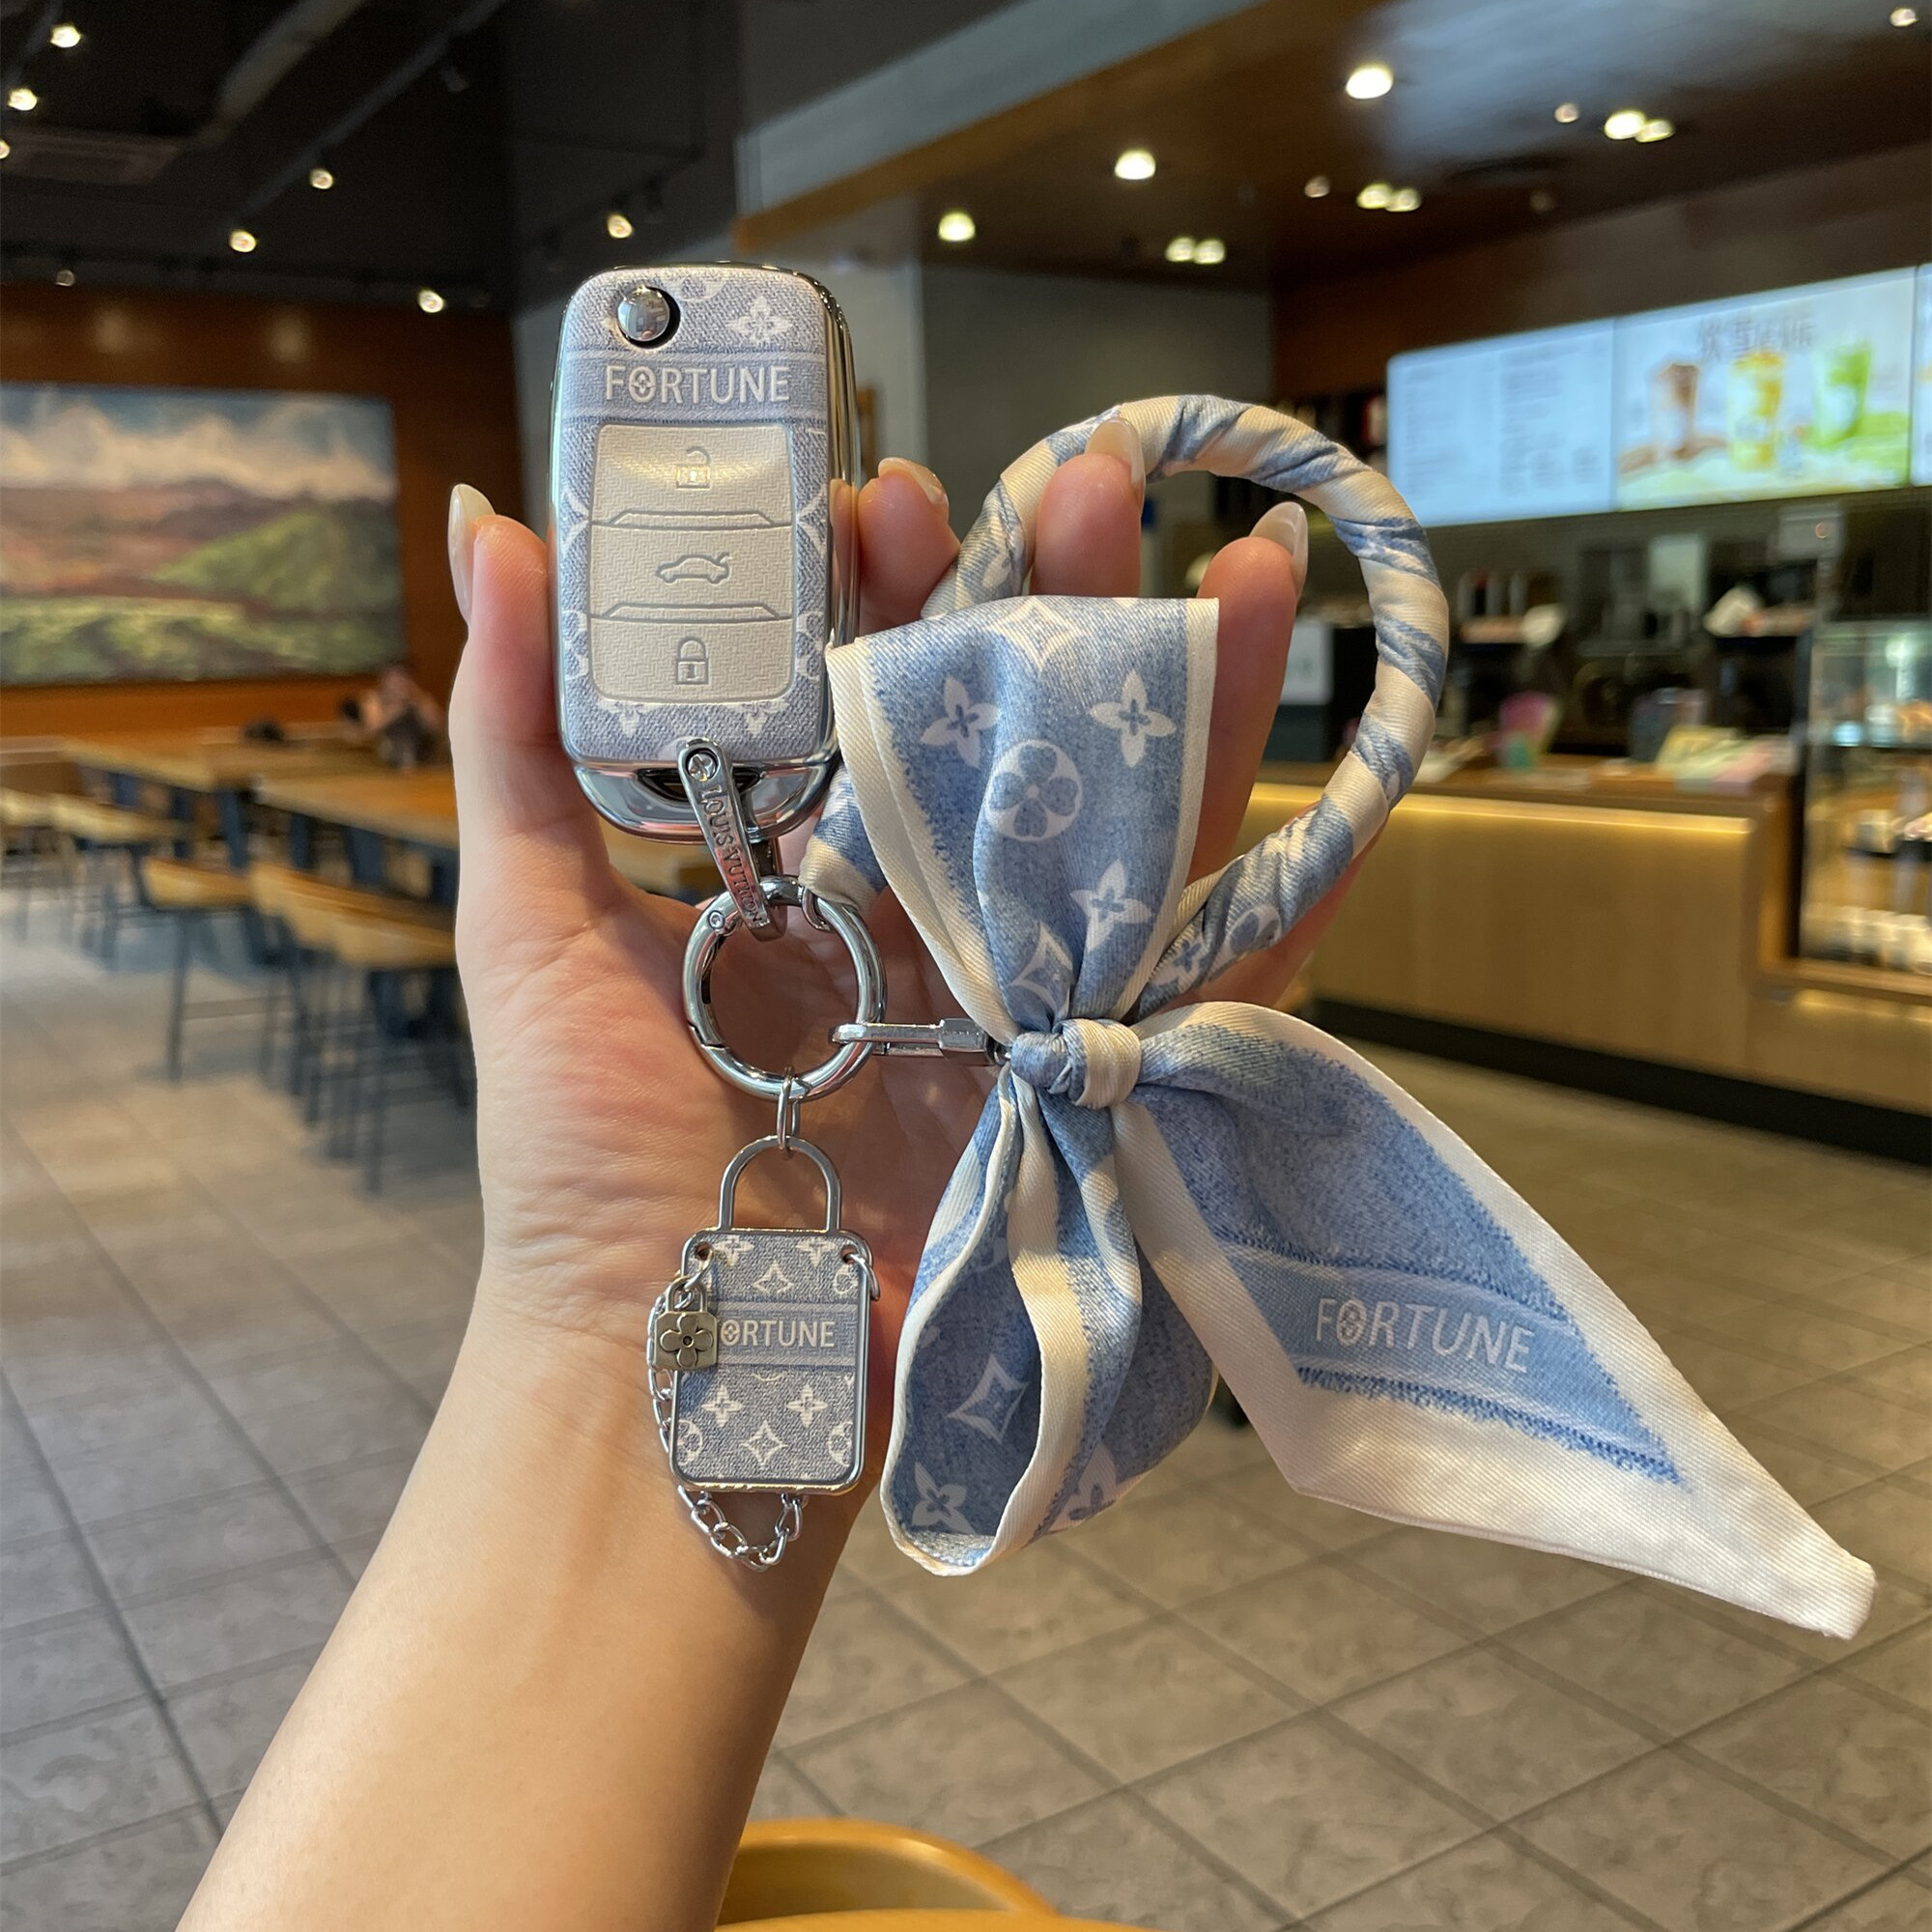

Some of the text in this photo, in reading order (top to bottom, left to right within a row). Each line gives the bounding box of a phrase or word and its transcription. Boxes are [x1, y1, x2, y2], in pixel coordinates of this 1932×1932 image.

[605, 363, 790, 405] FORTUNE
[718, 1319, 836, 1348] ORTUNE
[1316, 1297, 1535, 1374] FORTUNE
